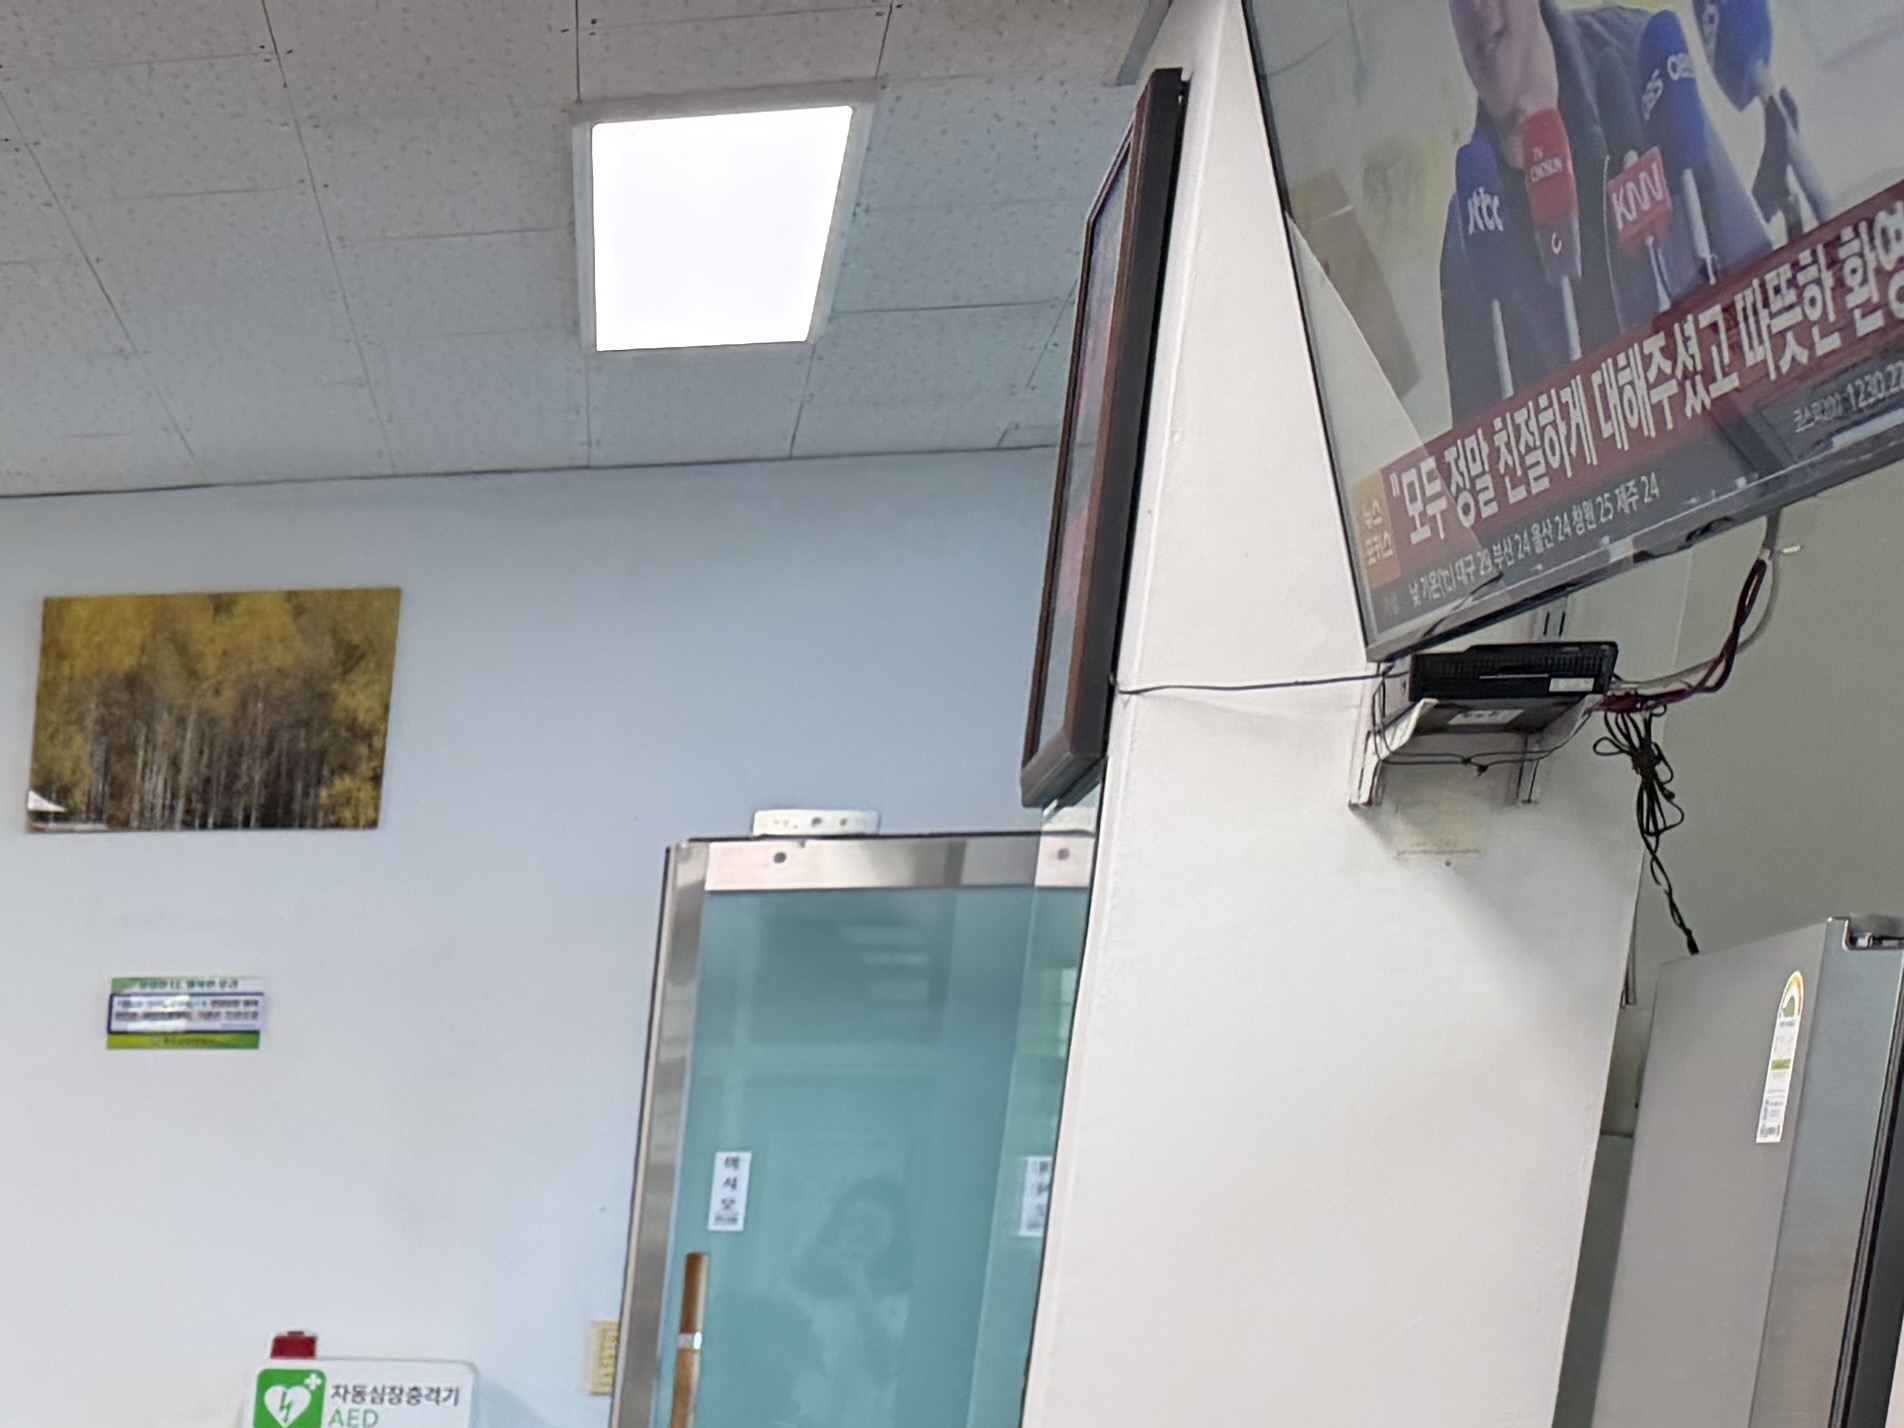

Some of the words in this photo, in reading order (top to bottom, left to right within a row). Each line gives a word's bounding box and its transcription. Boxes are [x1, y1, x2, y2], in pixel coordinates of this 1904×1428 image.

[1611, 161, 1664, 230] KNN
[1445, 428, 1498, 528] 정말
[1494, 375, 1597, 504] 친절하게
[1592, 304, 1740, 450] 대해주셨고
[1735, 244, 1841, 380] 따뜻한
[1515, 534, 1531, 561] 24
[1555, 514, 1571, 541] 24
[1596, 496, 1613, 523] 25
[1640, 472, 1660, 499] 24
[328, 1408, 379, 1428] AED
[330, 1383, 461, 1407] 자동심장충격기
